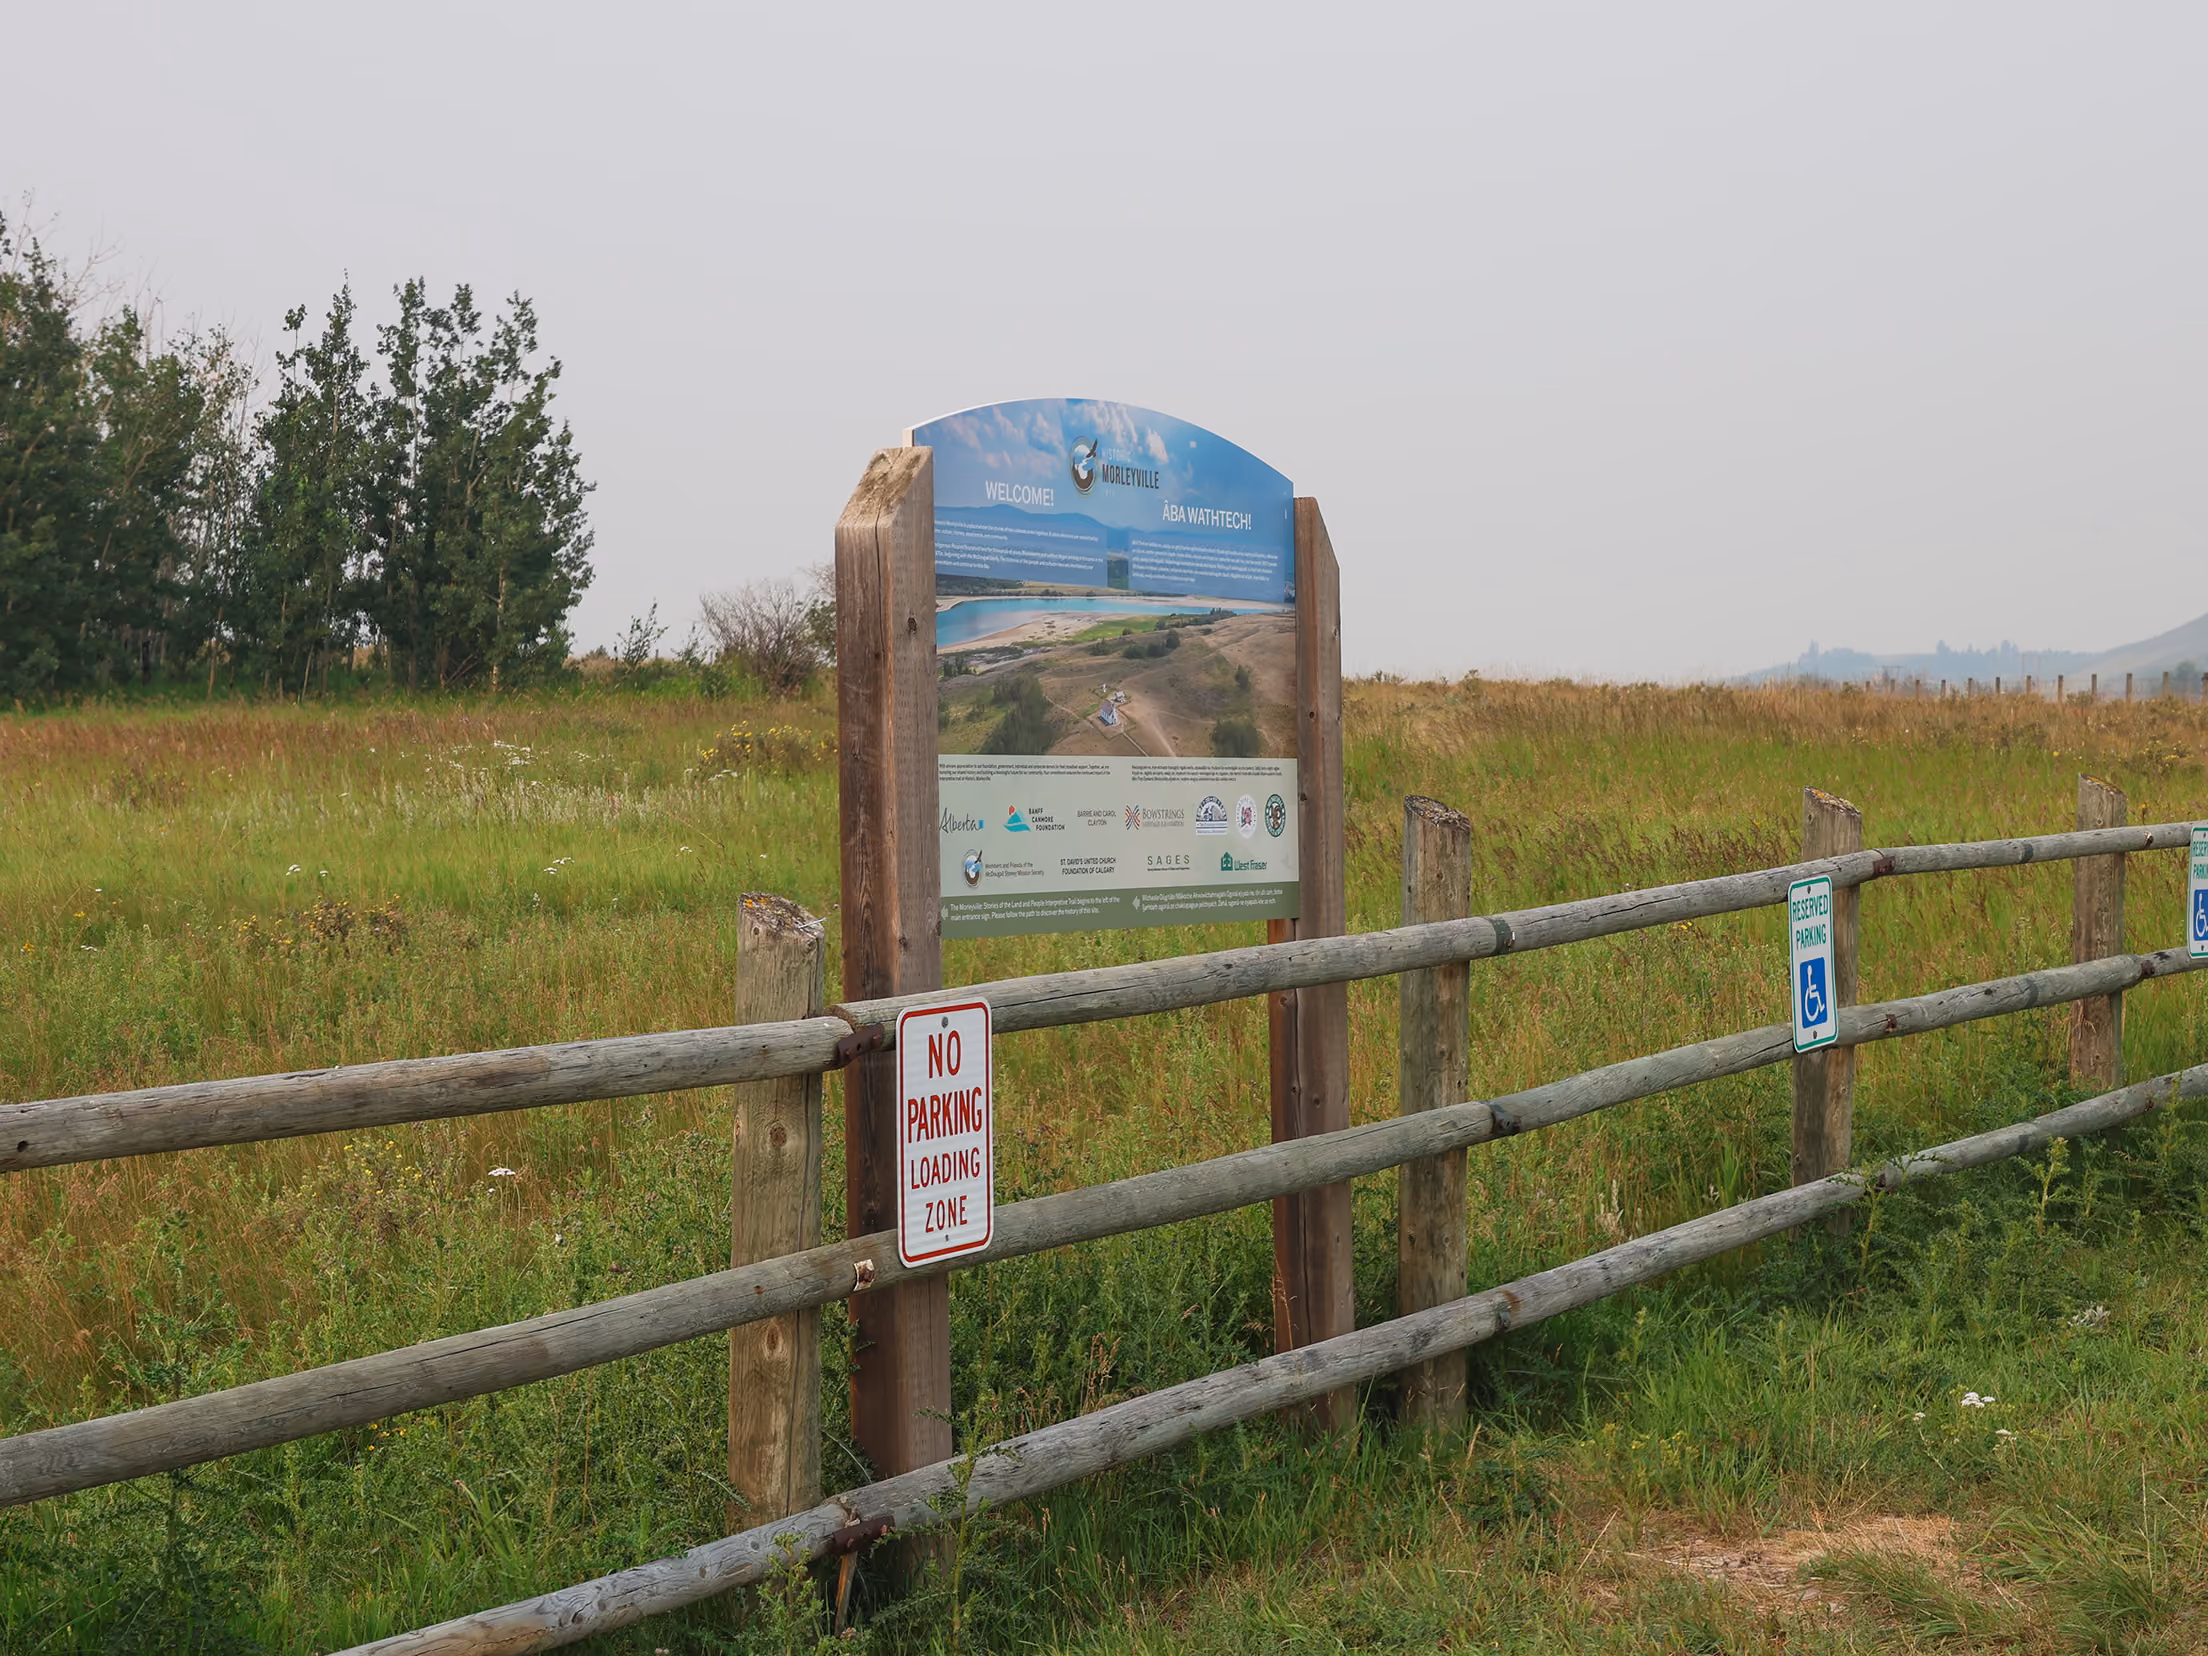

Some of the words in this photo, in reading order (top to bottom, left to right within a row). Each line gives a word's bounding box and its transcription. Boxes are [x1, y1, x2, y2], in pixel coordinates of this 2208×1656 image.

[1102, 463, 1160, 489] MORLEYVILLE
[985, 480, 1054, 507] WELCOME!
[1162, 499, 1186, 523] ÂBA
[1187, 506, 1252, 530] WATHTECH!
[939, 806, 980, 834] Alberta
[1143, 808, 1184, 819] BOWSTRINGS
[1062, 867, 1088, 875] FOUNDATION
[1234, 860, 1250, 871] West
[1792, 894, 1829, 923] RESERVED
[1796, 923, 1827, 951] PARKING
[928, 1030, 961, 1079] NO
[907, 1086, 982, 1144] PARKING
[911, 1147, 980, 1190] LOADING
[925, 1195, 968, 1233] ZONE
